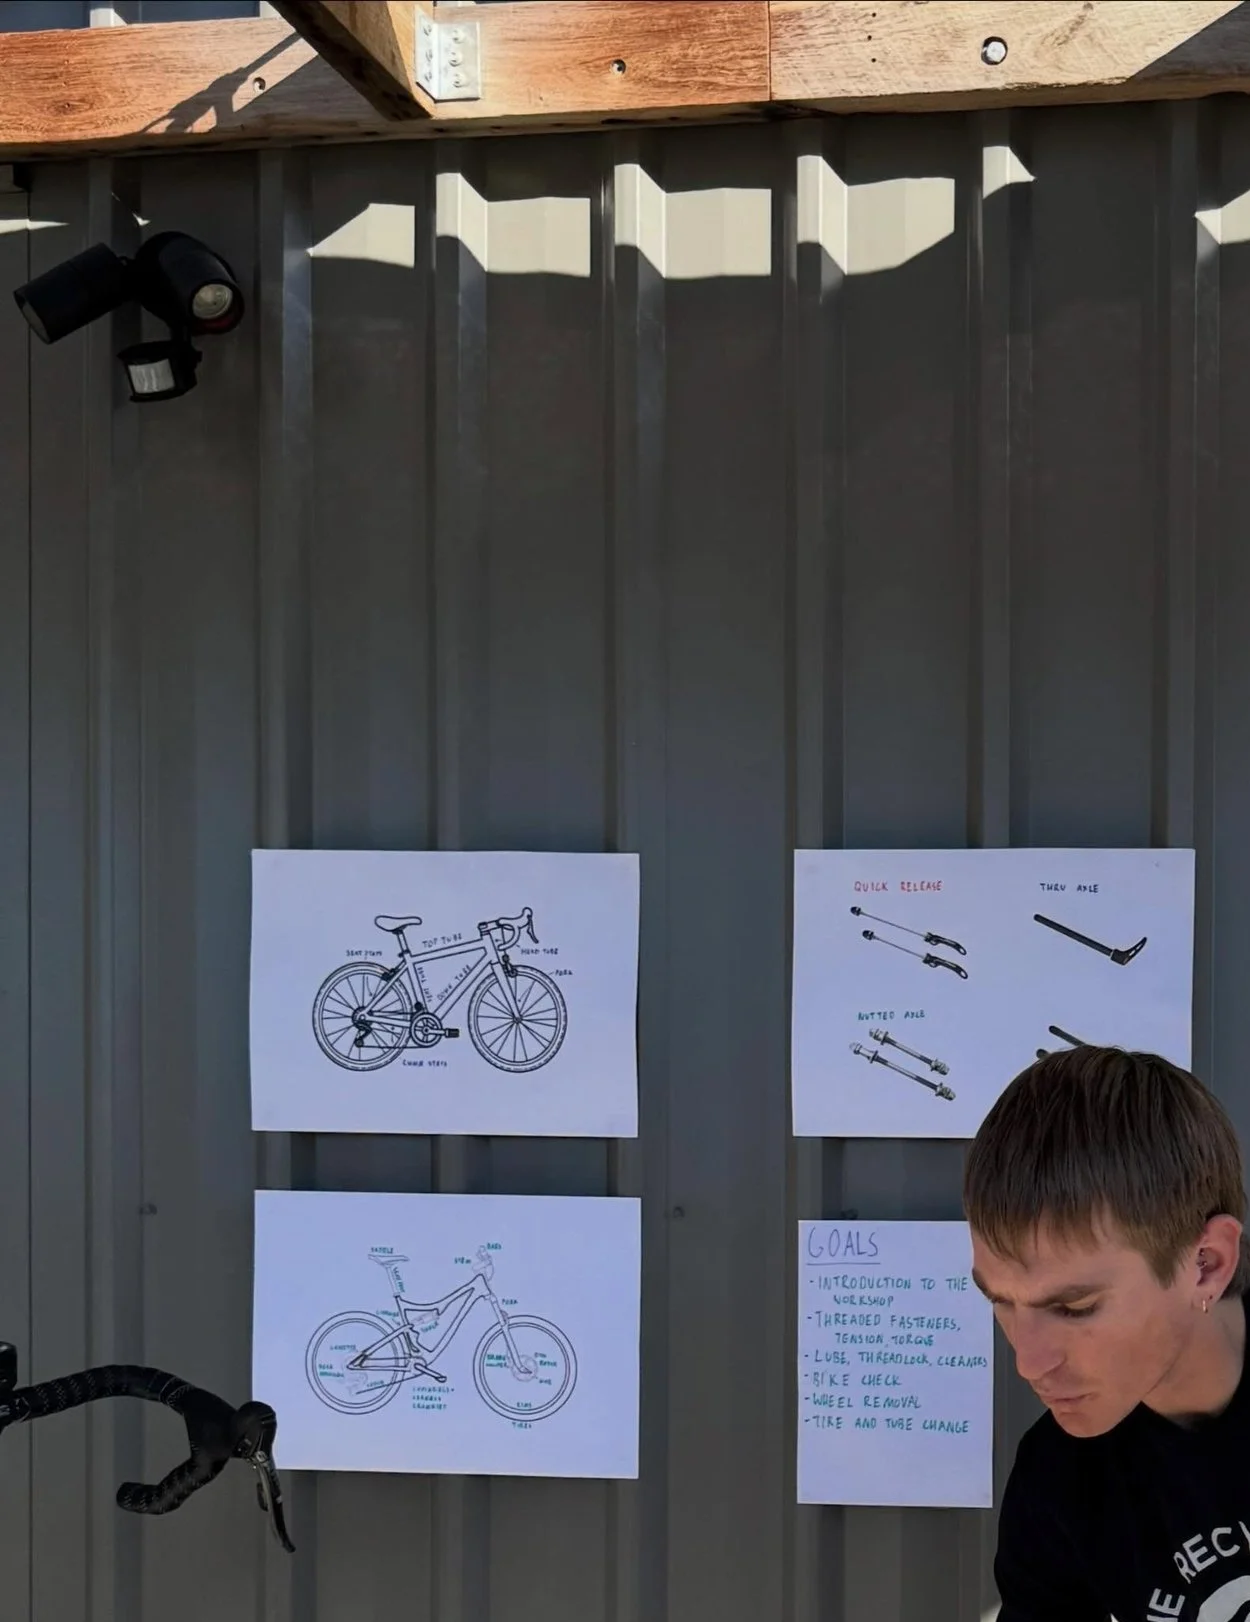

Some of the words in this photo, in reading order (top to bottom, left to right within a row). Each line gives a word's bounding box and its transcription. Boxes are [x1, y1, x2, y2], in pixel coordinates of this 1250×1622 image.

[854, 881, 888, 893] QUICK
[900, 880, 942, 893] RELEASE
[1040, 882, 1066, 893] THRU
[1077, 883, 1100, 894] AXLE
[858, 1011, 895, 1022] NUTTED
[904, 1010, 925, 1020] AXLE
[808, 1226, 879, 1258] GOALS
[921, 1277, 935, 1291] TO
[946, 1276, 968, 1291] THE
[834, 1295, 895, 1307] WORKSHOP
[891, 1335, 934, 1347] TORQUE
[937, 1354, 988, 1368] CLEANERS
[861, 1374, 902, 1386] CHECK
[863, 1396, 922, 1409] REMOVAL
[855, 1417, 877, 1429] AND
[886, 1418, 913, 1431] TUBE
[922, 1419, 969, 1433] CHANGE
